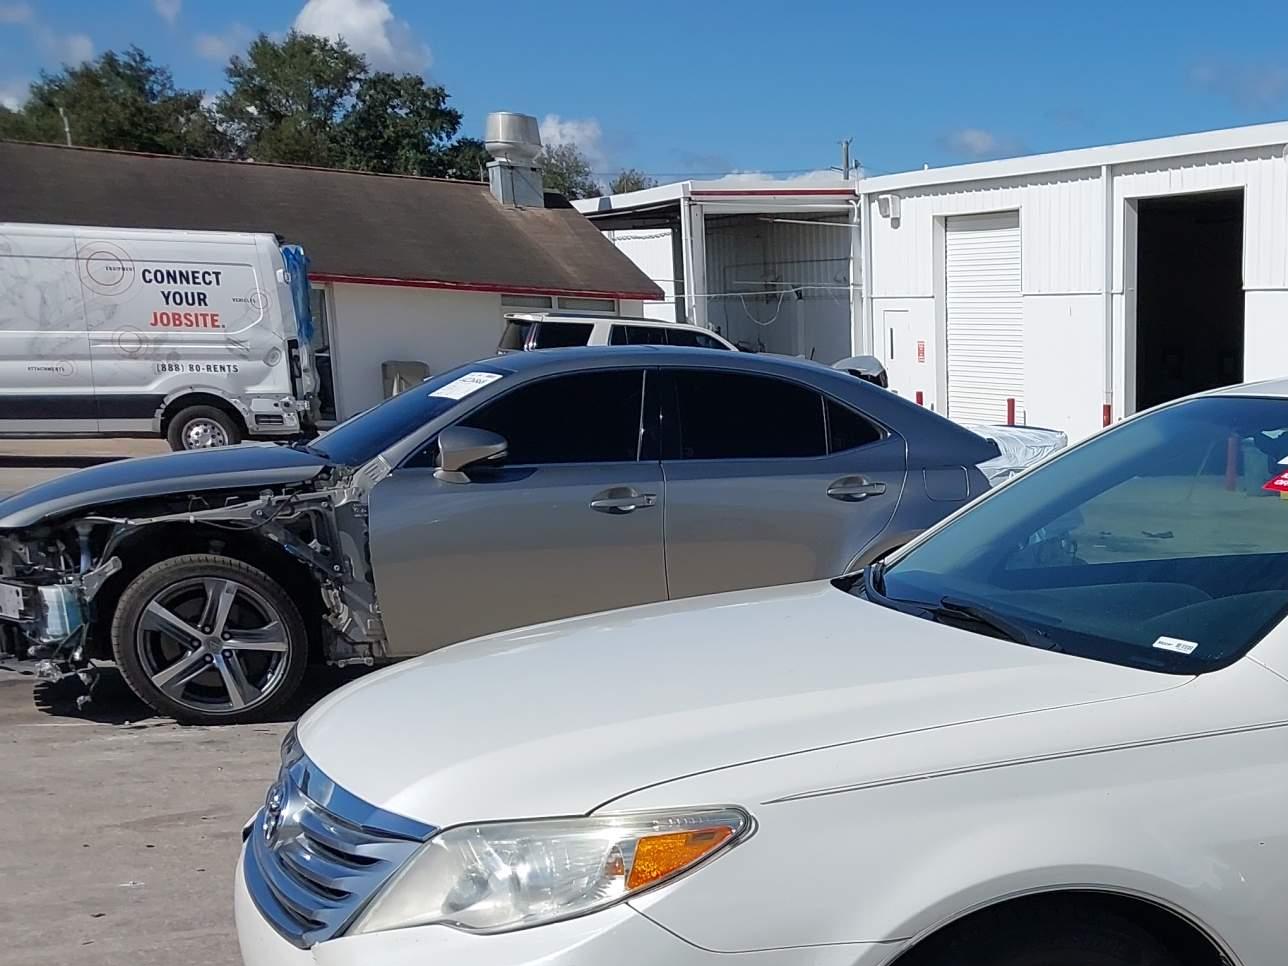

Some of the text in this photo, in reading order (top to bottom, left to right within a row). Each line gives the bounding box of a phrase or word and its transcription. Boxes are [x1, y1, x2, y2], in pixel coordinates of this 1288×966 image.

[142, 268, 222, 286] CONNECT
[160, 290, 208, 307] YOUR
[150, 311, 226, 328] JOBSITE.
[156, 363, 240, 373] (888) 80-RENTS
